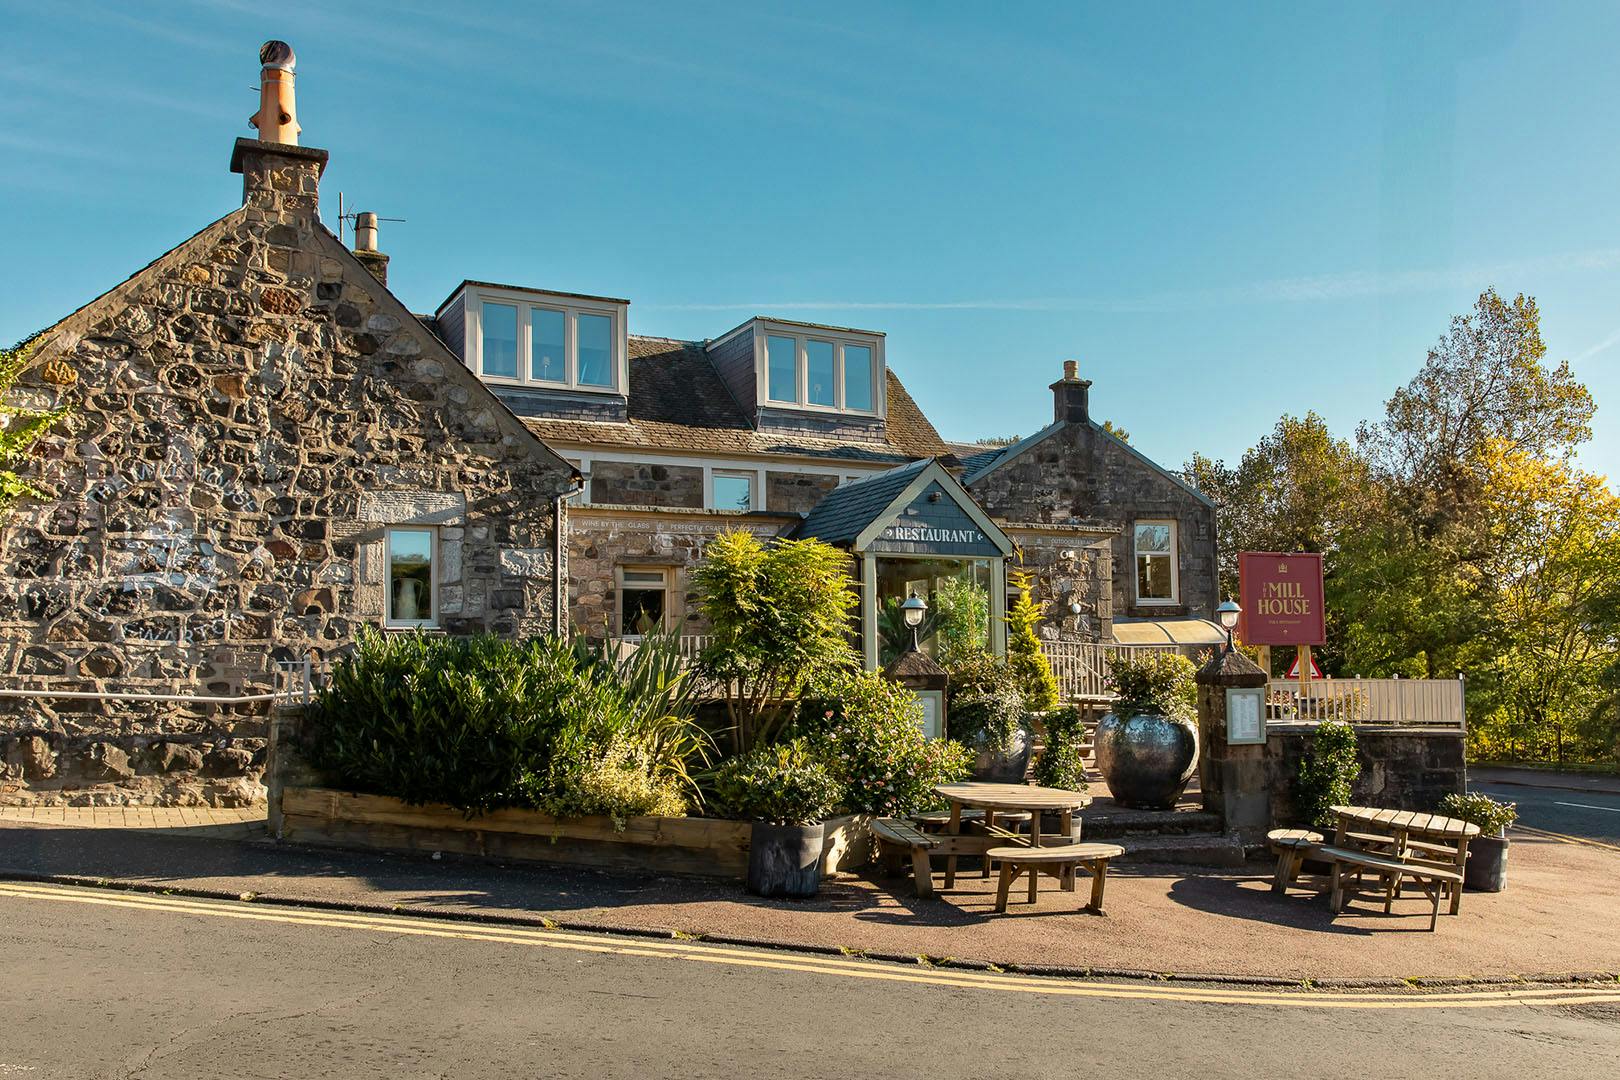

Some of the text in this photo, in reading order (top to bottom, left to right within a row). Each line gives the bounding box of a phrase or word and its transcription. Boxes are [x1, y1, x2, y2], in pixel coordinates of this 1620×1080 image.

[581, 519, 600, 527] WINE
[895, 527, 975, 543] RESTAURANT
[1268, 582, 1305, 598] MILL
[1257, 599, 1311, 615] HOUSE
